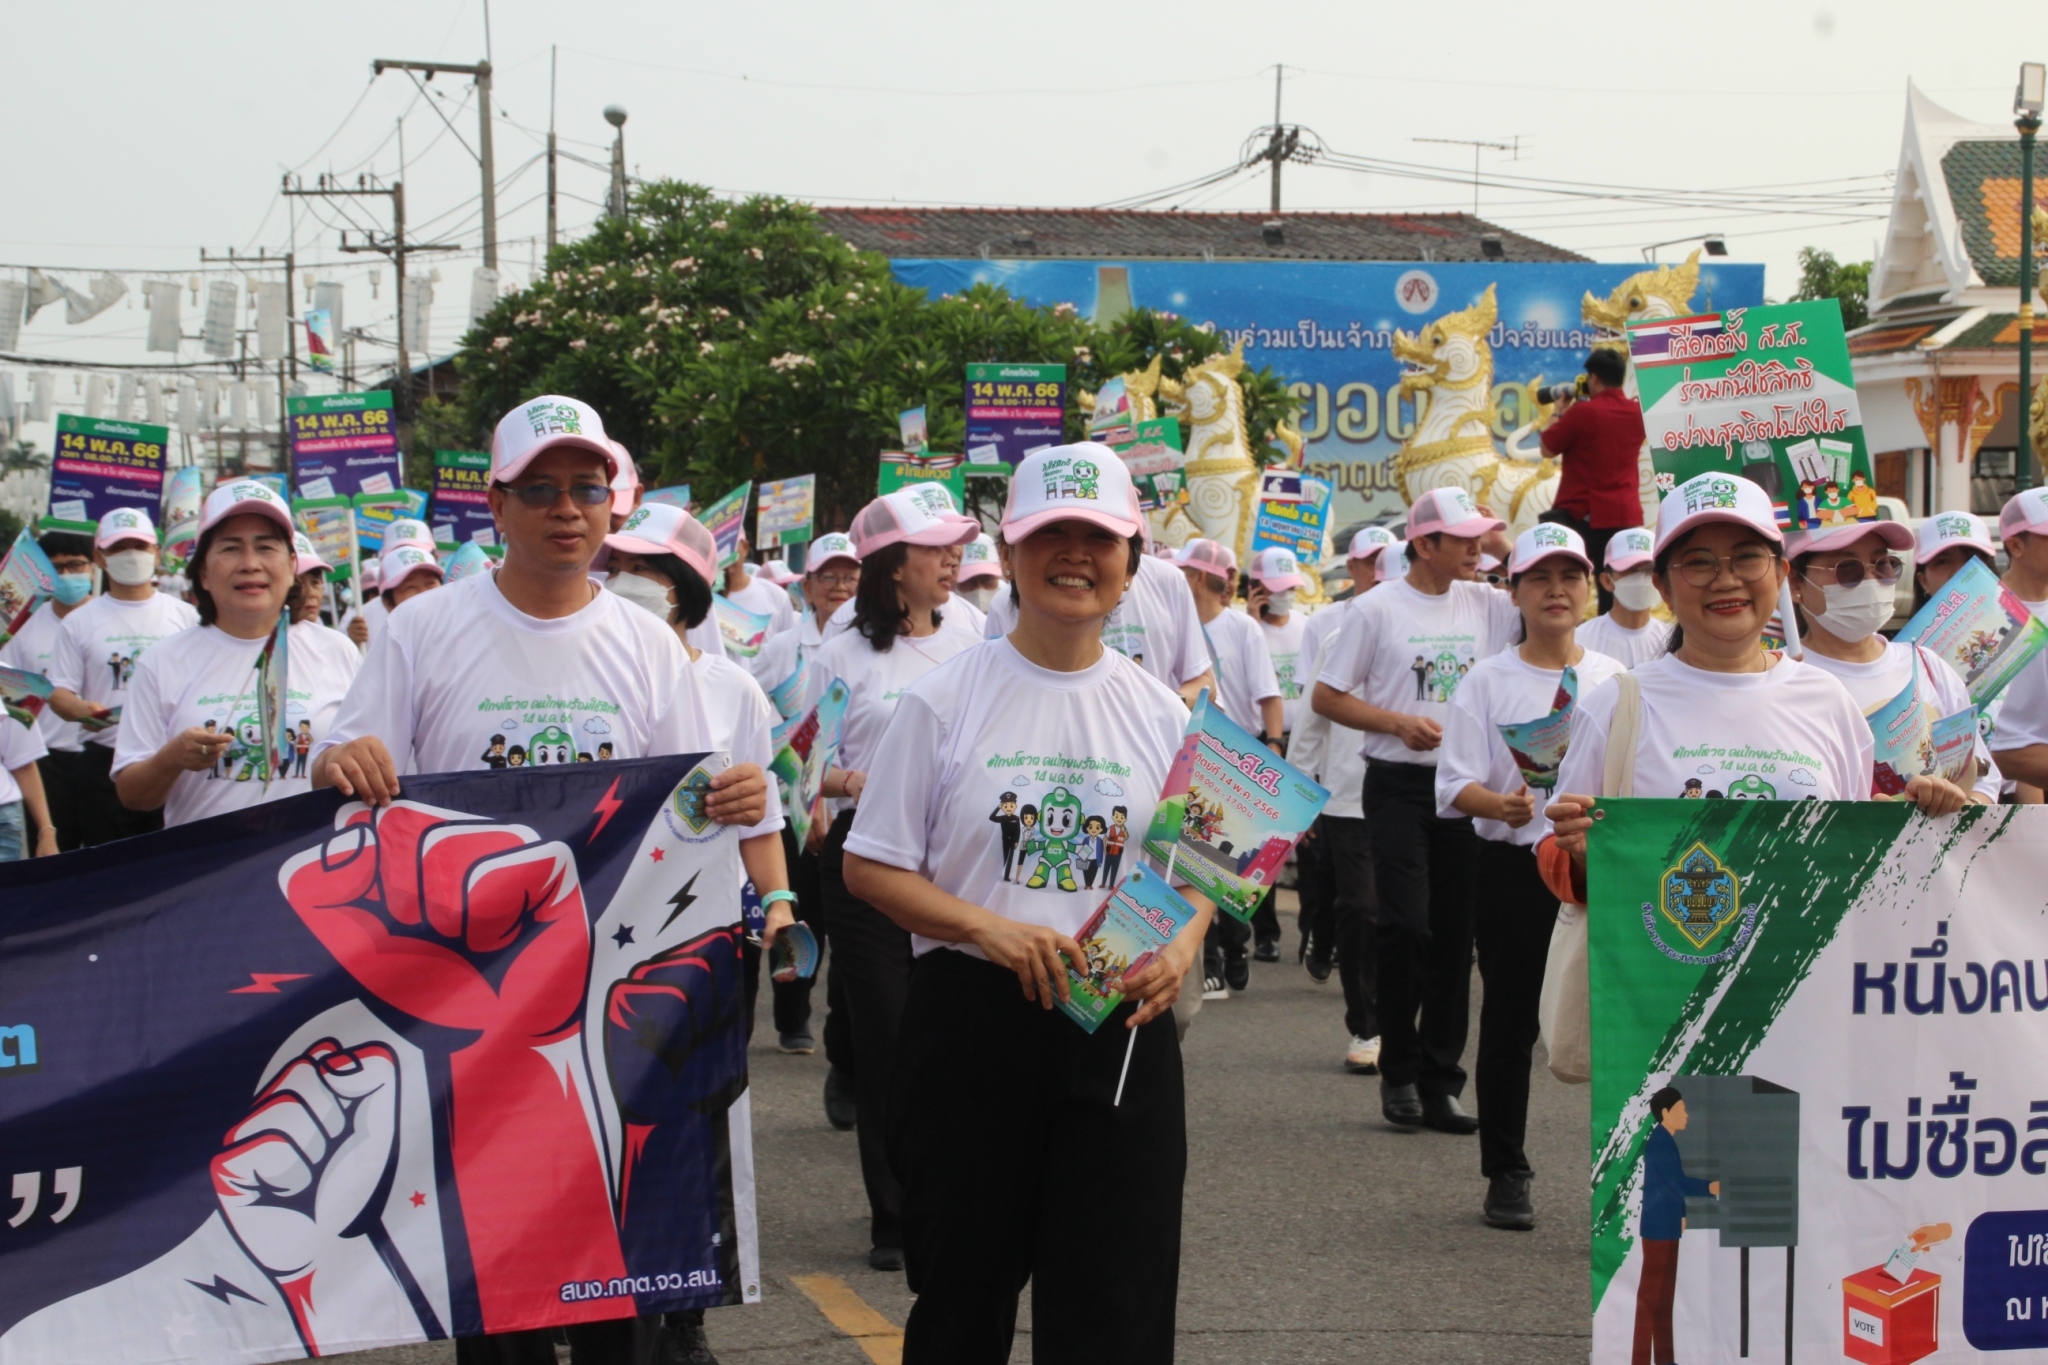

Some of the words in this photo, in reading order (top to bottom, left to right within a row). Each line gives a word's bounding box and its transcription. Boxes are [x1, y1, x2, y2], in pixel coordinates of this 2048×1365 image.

[1668, 308, 1748, 359] เลือกตั้ง
[1758, 322, 1807, 350] ส.ส.
[1679, 358, 1813, 403] ร่วมกันใช้สิทธิ
[972, 382, 994, 397] 14
[997, 384, 1032, 397] พ.ค.
[1035, 383, 1059, 398] 66
[295, 414, 320, 430] 14
[321, 413, 361, 428] พ.ค.
[362, 409, 389, 426] 66
[1662, 397, 1848, 460] อย่างสุจริตโปร่งใส
[61, 433, 86, 450] 14
[90, 438, 130, 456] พ.ค.
[132, 442, 160, 459] 66
[438, 466, 454, 480] 14
[478, 694, 528, 712] #ไทยโหวต
[522, 713, 535, 724] 14
[537, 713, 558, 724] พ.ค.
[559, 712, 574, 724] 66
[1672, 743, 1726, 760] #ไทยโหวต
[986, 750, 1039, 769] #ไทยโหวต
[1042, 752, 1132, 778] คนไทยพร้อมใช้สิทธิ
[1719, 757, 1733, 770] 14
[1735, 761, 1758, 773] พ.ค.
[1760, 761, 1776, 774] 66
[1034, 769, 1047, 783] 14
[1049, 772, 1066, 785] พ.ค.
[1068, 771, 1084, 786] 66
[1219, 771, 1233, 786] 14
[1232, 780, 1252, 802] พ.ค.
[1252, 798, 1281, 821] 2566
[1047, 847, 1063, 856] ECT
[560, 1269, 723, 1302] สนง.กกต.จว.สน.
[1854, 1318, 1876, 1335] VOTE
